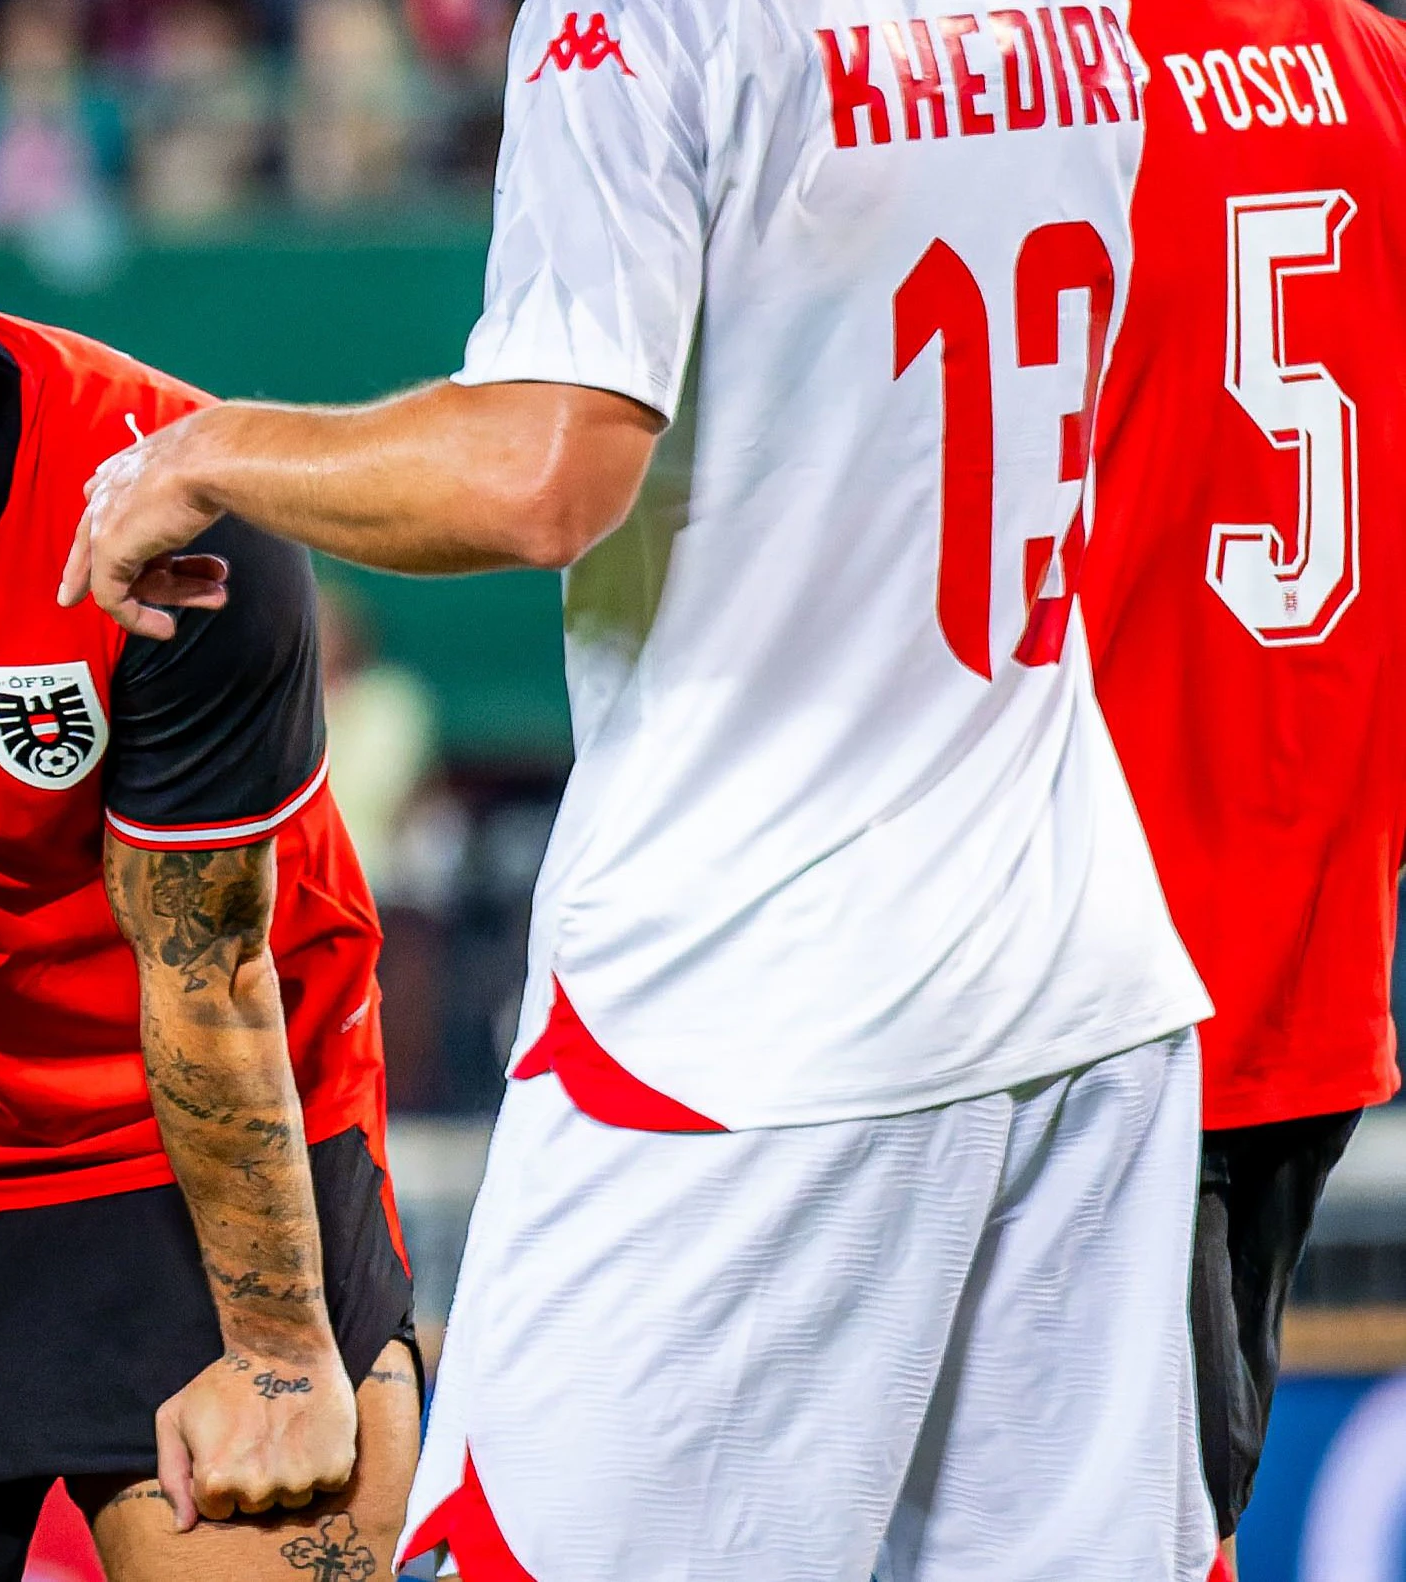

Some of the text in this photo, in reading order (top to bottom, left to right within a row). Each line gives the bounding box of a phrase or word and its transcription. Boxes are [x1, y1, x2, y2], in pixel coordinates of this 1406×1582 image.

[1163, 44, 1349, 134] POSCH
[892, 220, 1115, 683] 13
[1205, 189, 1360, 647] 5
[8, 675, 56, 689] ÖFB
[253, 1368, 314, 1400] Love
